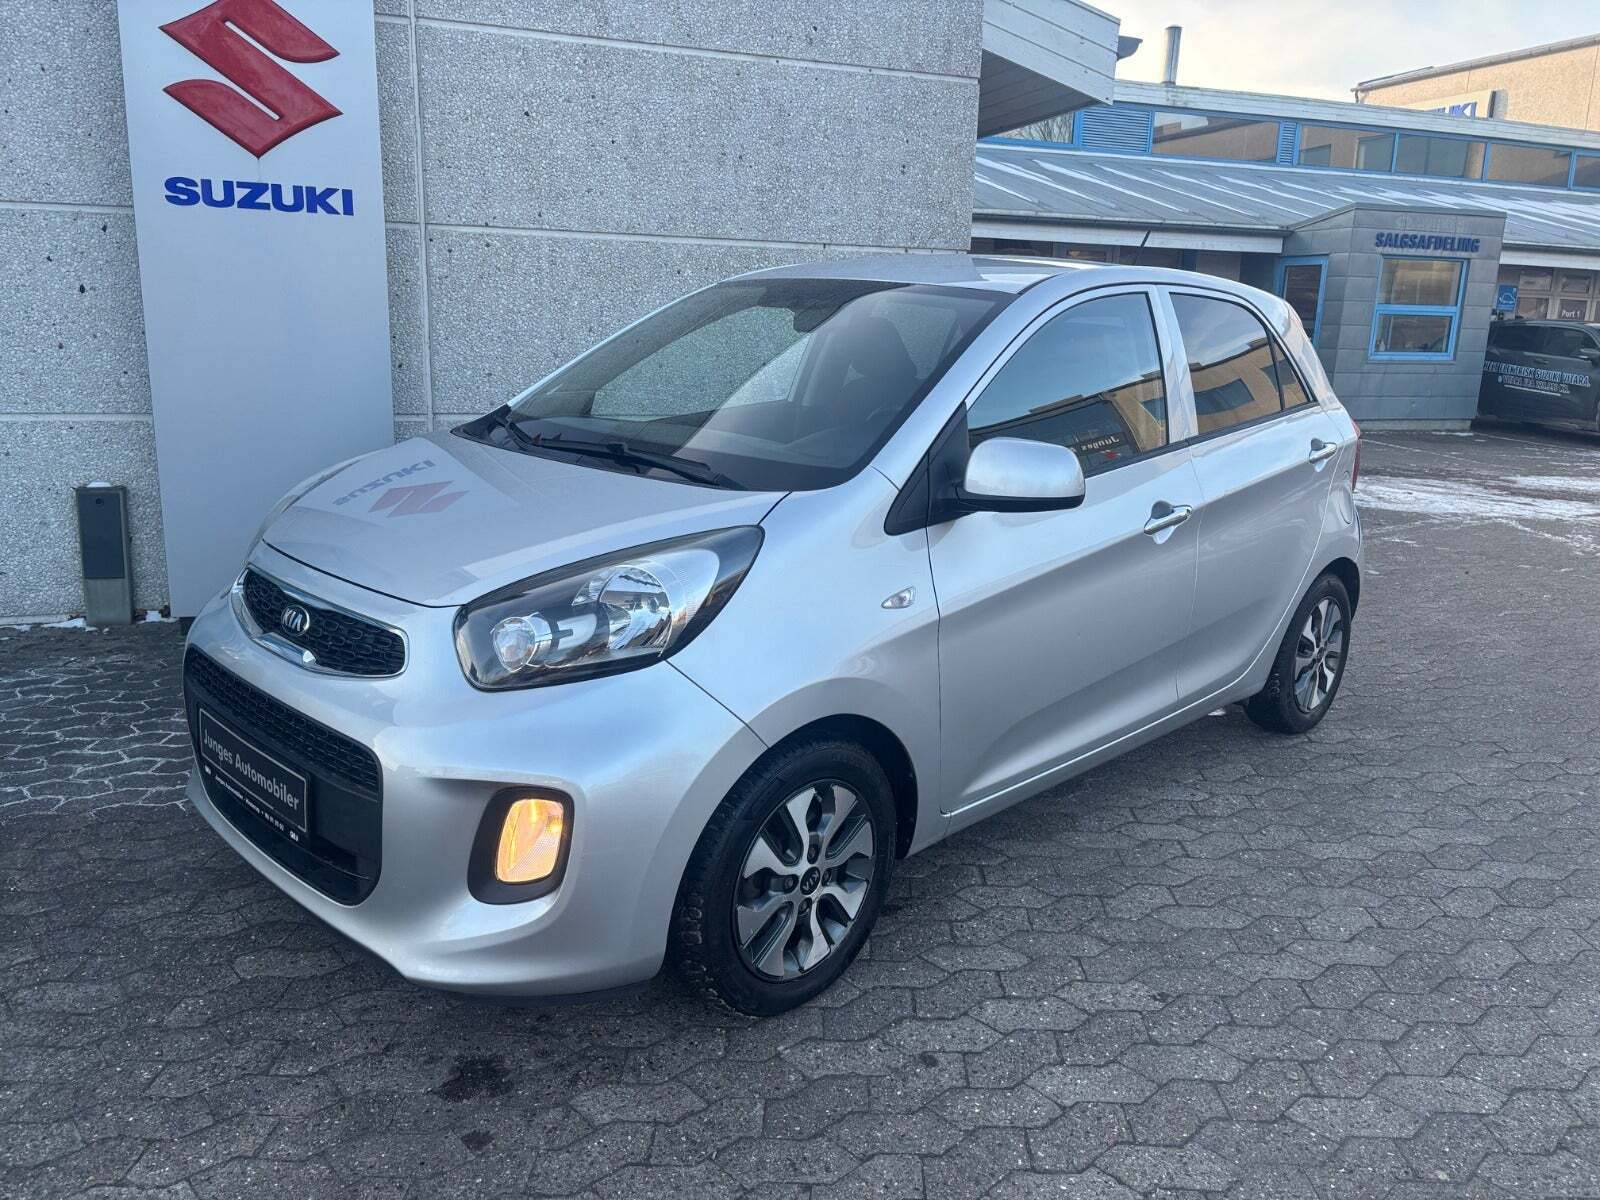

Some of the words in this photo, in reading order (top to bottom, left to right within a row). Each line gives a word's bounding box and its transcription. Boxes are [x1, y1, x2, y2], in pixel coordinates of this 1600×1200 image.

[164, 176, 354, 216] SUZUKI
[1375, 232, 1481, 252] SALGSAFDELING
[1561, 310, 1575, 318] Port
[203, 729, 234, 764] Junges
[235, 753, 299, 810] Automobiler
